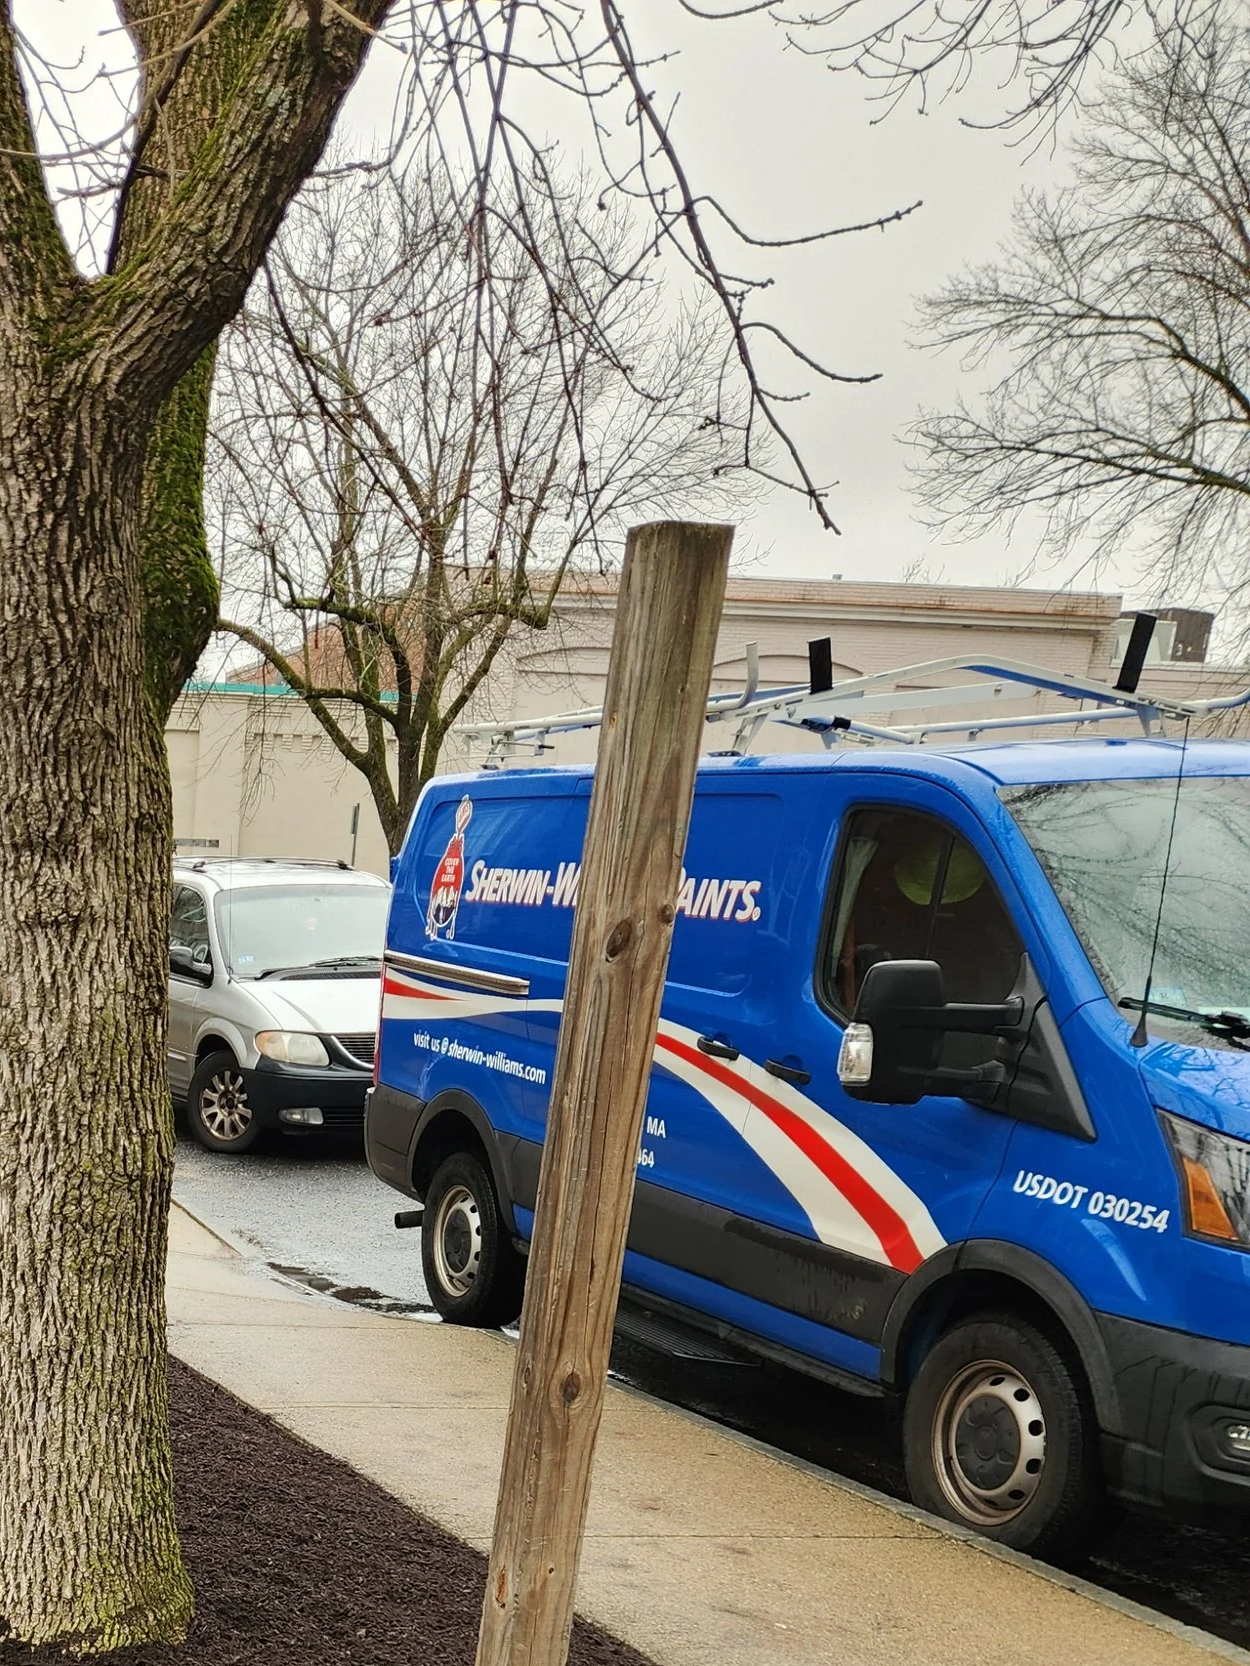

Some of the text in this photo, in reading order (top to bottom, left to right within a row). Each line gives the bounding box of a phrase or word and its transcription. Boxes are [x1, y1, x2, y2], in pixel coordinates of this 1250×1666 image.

[444, 857, 460, 866] COVER
[465, 859, 582, 907] SHERWIN-W
[413, 1029, 546, 1085] visit us @ sherwin-williams.com
[646, 1116, 667, 1138] MA
[1013, 1169, 1171, 1233] USDOT 030254
